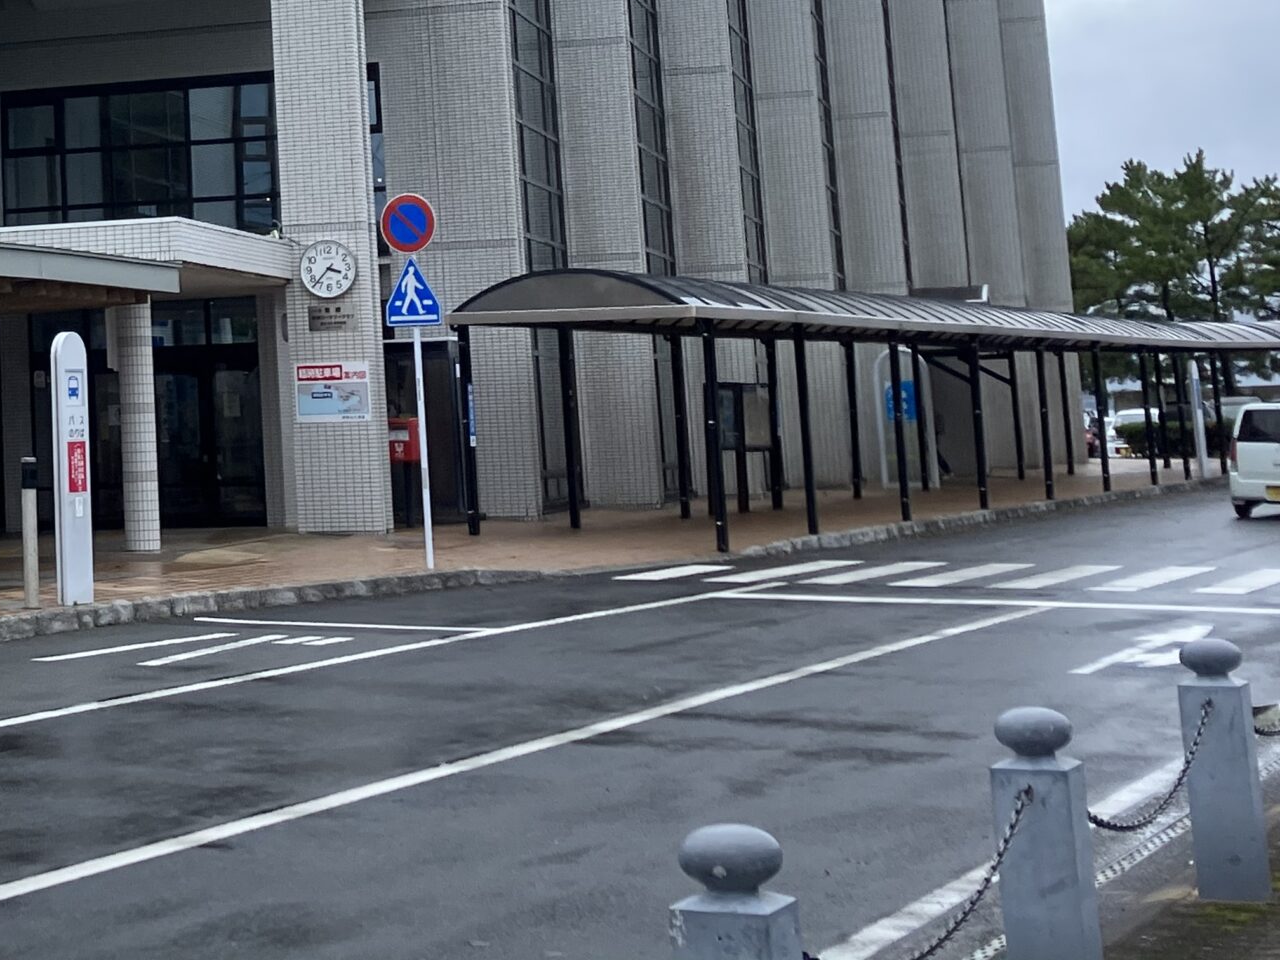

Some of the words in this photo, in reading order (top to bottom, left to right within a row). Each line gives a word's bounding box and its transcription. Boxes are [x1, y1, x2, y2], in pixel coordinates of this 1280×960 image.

[322, 245, 332, 254] 12
[307, 256, 316, 265] 10
[341, 253, 348, 262] 2
[306, 266, 312, 274] 9
[344, 263, 351, 271] 3
[310, 275, 316, 283] 8
[326, 283, 333, 292] 6
[336, 280, 342, 289] 5
[68, 416, 84, 425] バス
